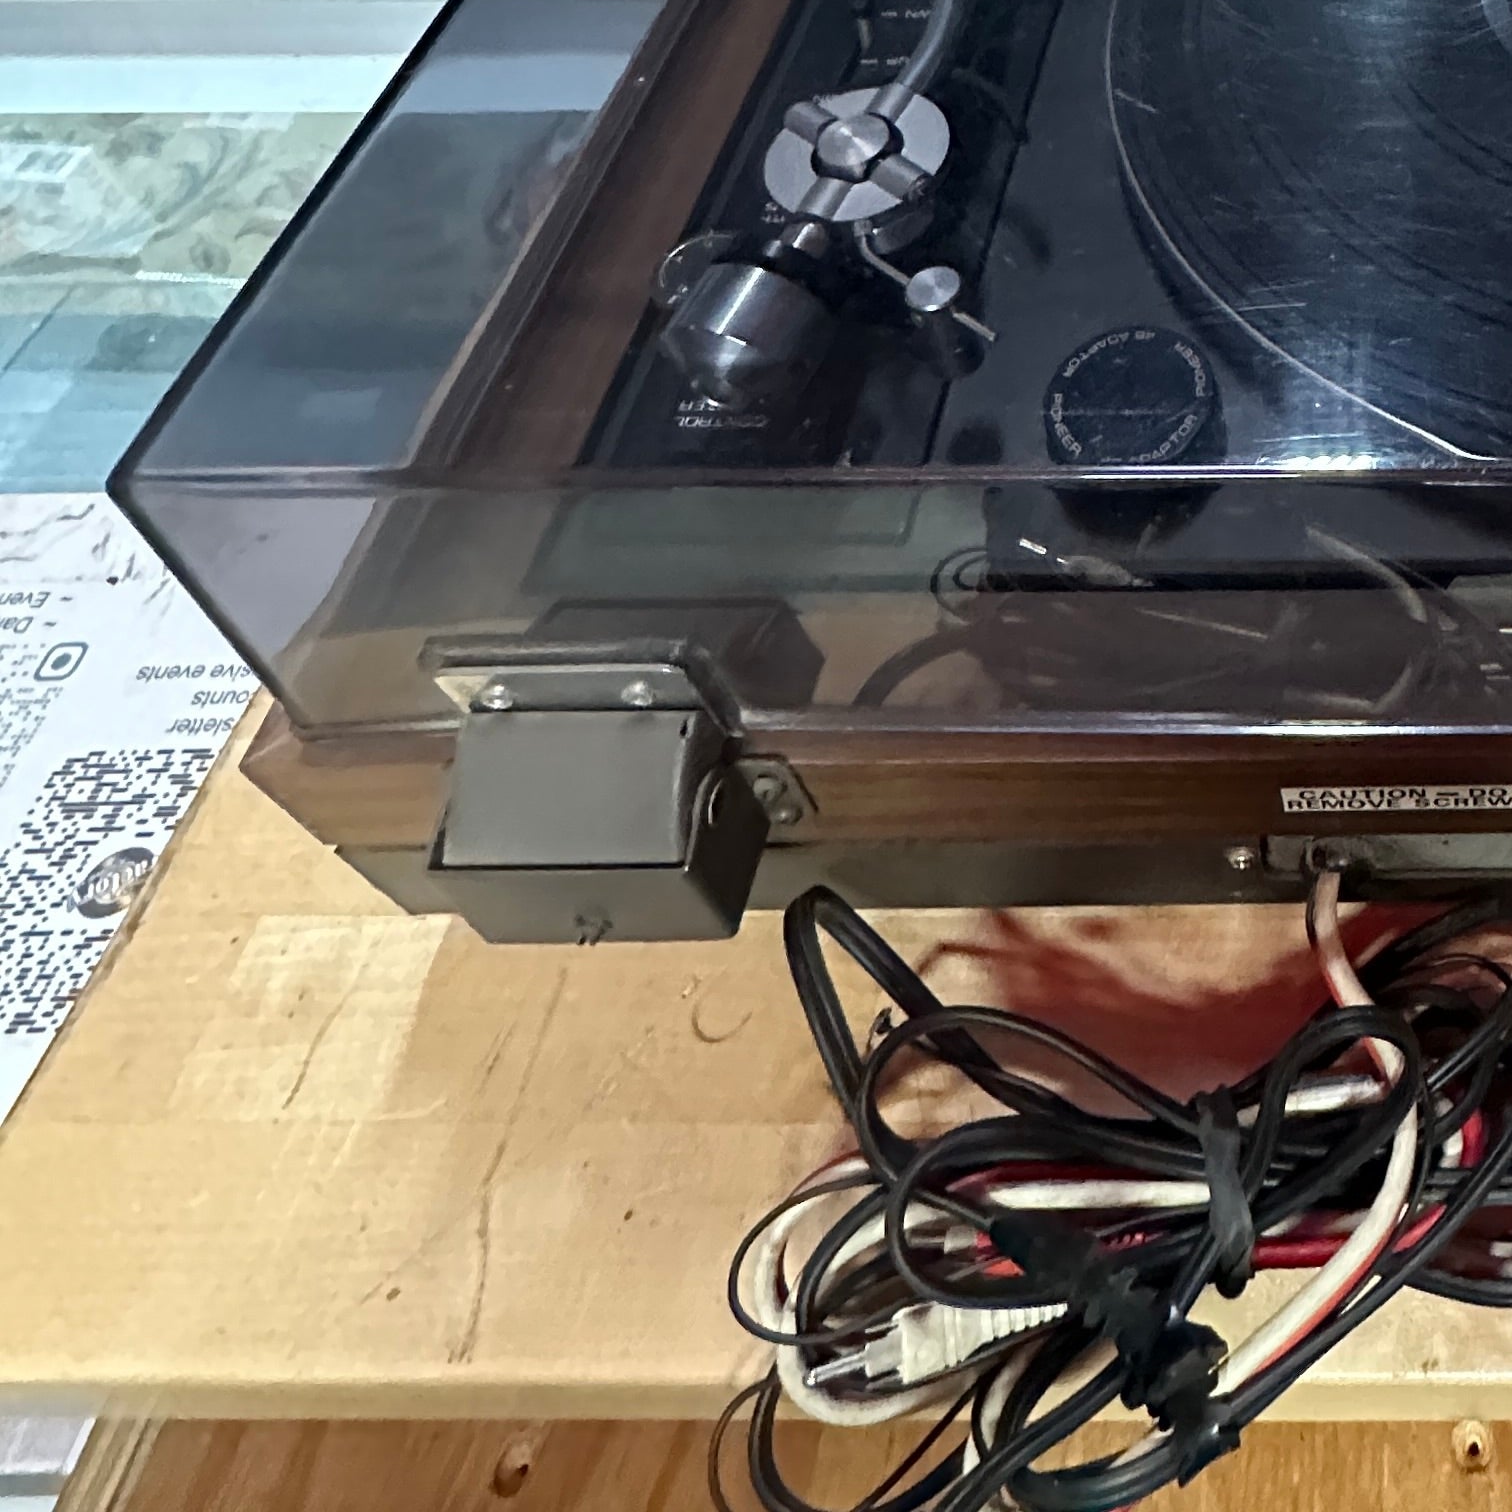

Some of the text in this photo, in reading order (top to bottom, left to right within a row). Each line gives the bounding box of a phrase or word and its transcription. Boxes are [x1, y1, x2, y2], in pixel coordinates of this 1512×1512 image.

[1062, 331, 1131, 378] ADAPTOR
[1173, 341, 1207, 398] PIONEER
[1050, 392, 1083, 460] PIONEER
[1128, 413, 1199, 463] ADAPTOR
[135, 663, 256, 681] sive events
[190, 689, 252, 706] ounts
[165, 718, 236, 735] sletter
[1299, 788, 1427, 800] CAUTION
[1469, 787, 1508, 798] DO
[1287, 797, 1401, 810] REMOVE
